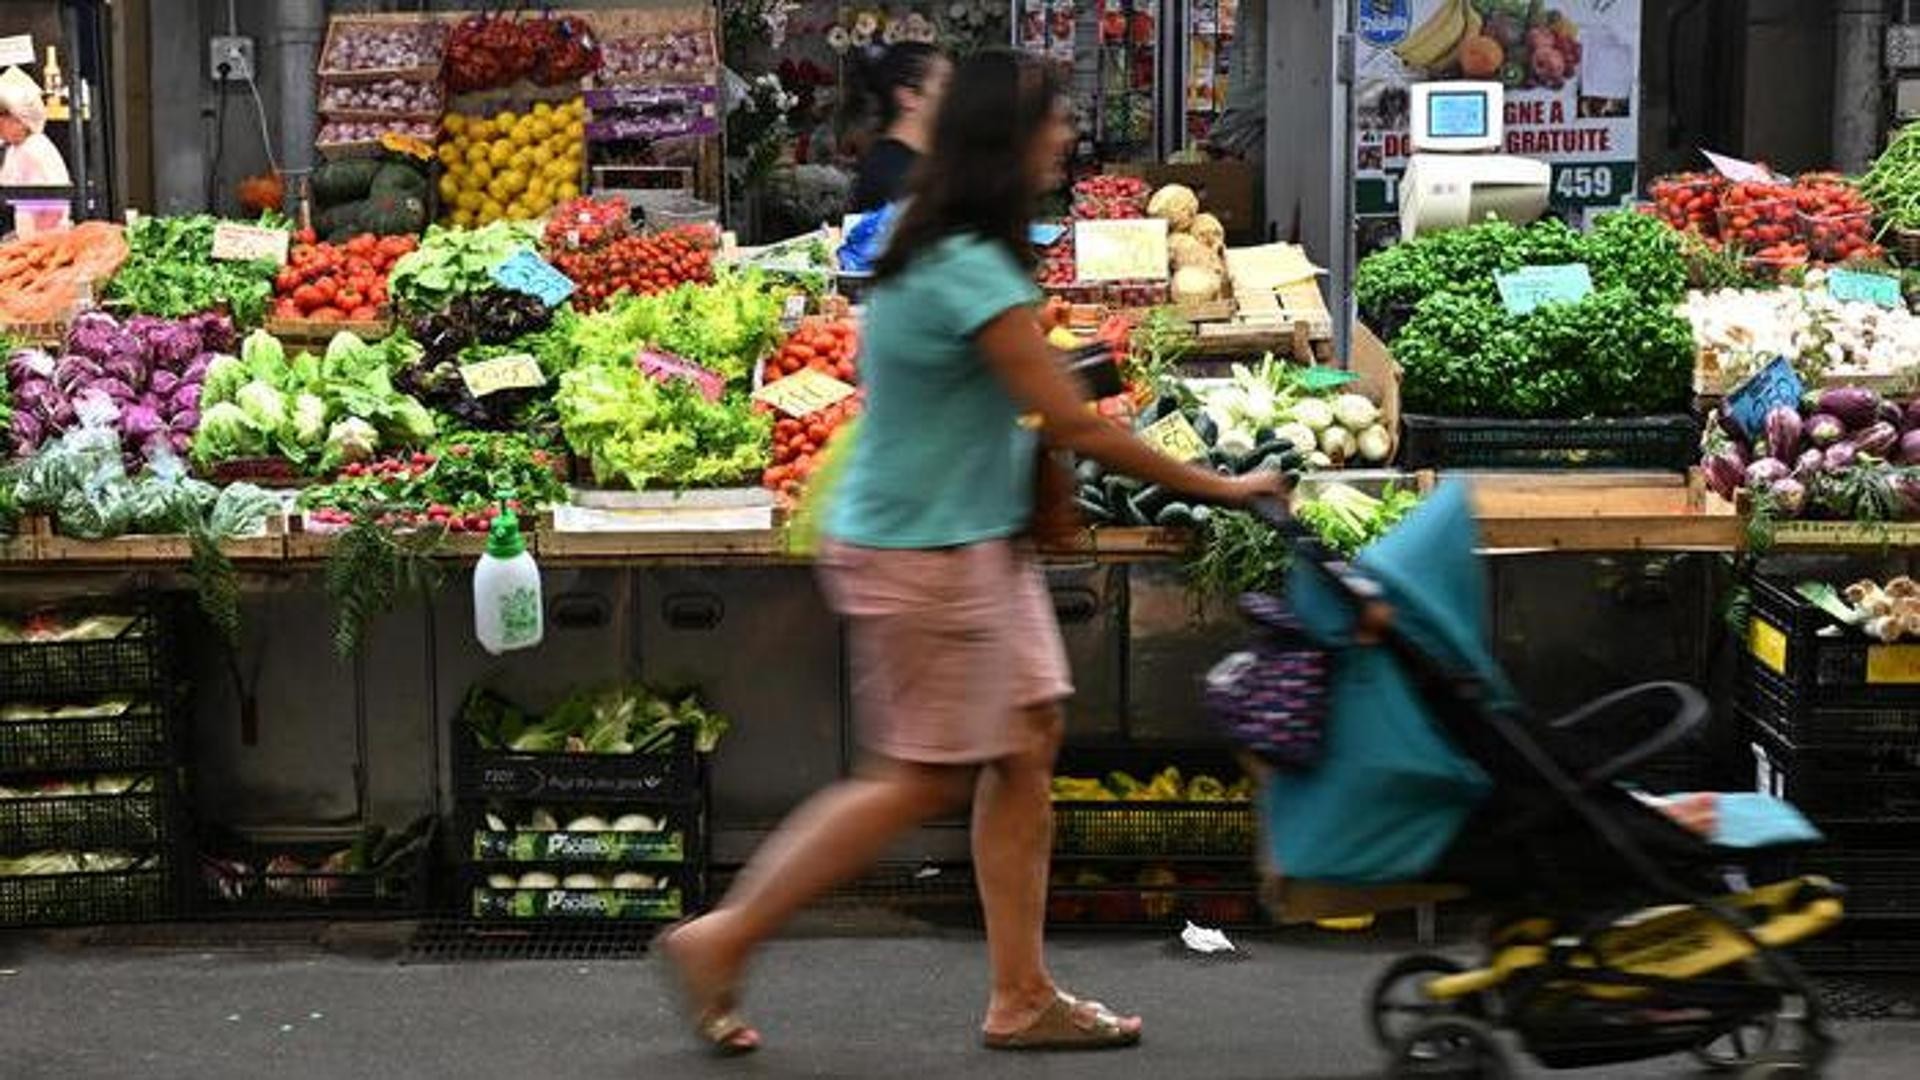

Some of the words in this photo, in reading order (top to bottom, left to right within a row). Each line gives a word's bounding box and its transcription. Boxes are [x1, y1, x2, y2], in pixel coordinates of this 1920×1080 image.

[1550, 100, 1564, 123] A
[1508, 130, 1610, 154] GRATUITE
[1556, 166, 1612, 197] 459
